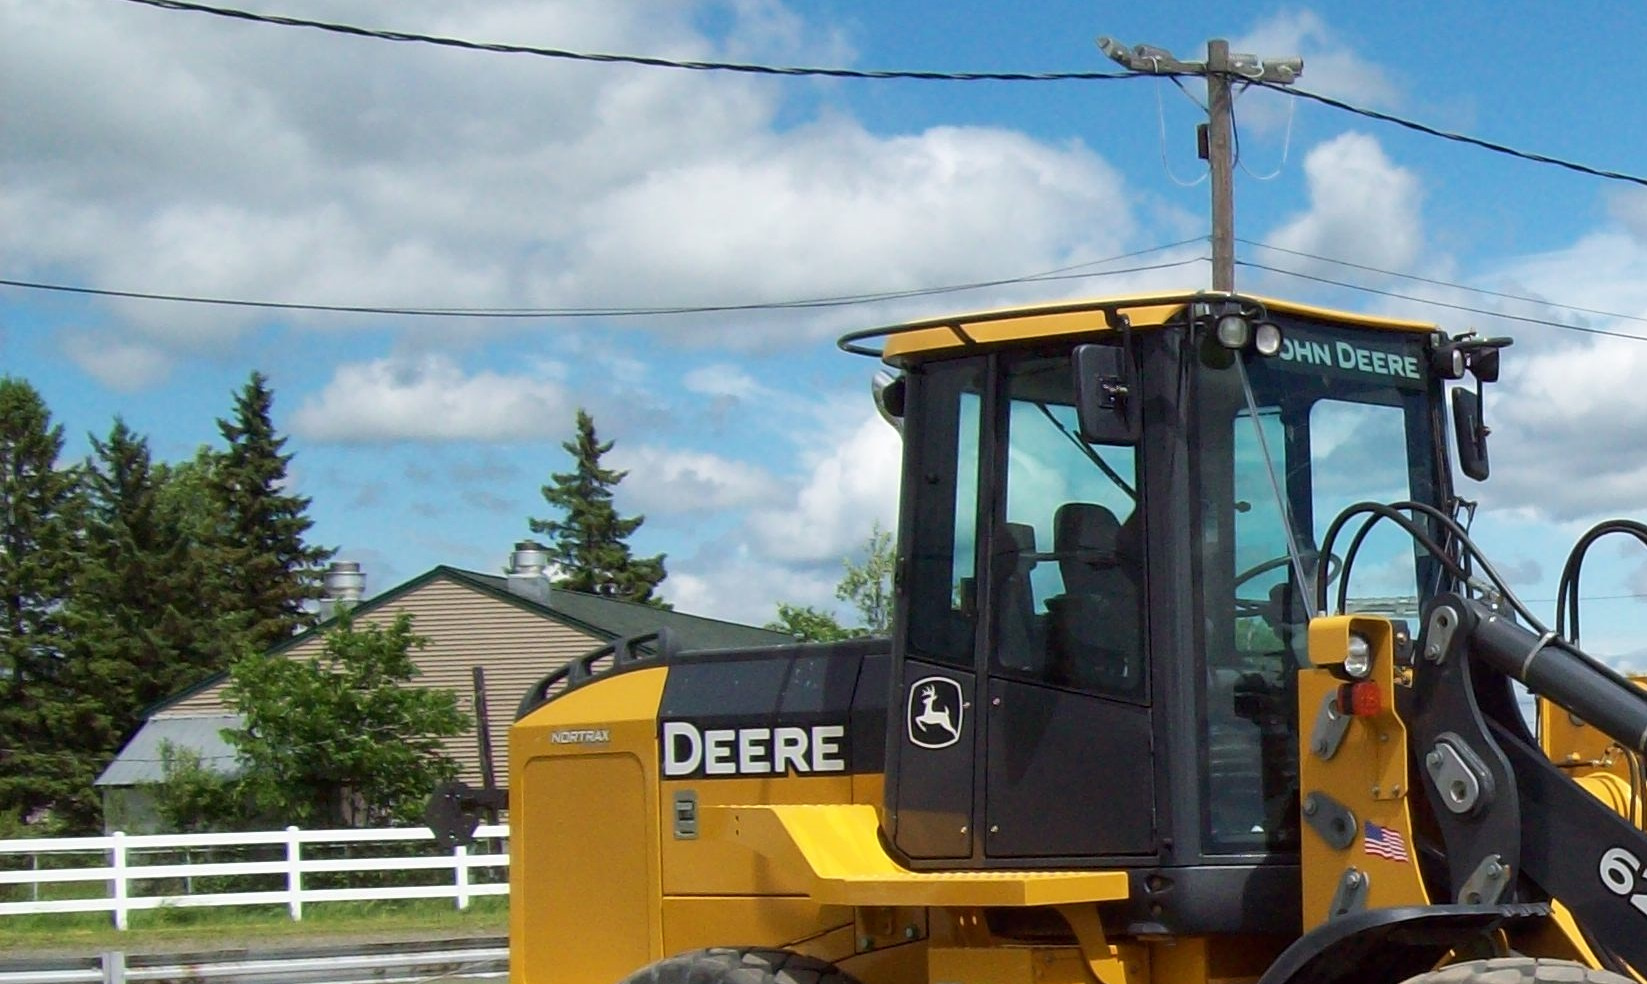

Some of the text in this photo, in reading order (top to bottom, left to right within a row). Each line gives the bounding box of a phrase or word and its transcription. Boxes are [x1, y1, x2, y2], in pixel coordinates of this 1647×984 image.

[1279, 339, 1421, 379] OHN DEERE
[551, 729, 610, 744] NORTRAX
[663, 721, 845, 776] DEERE
